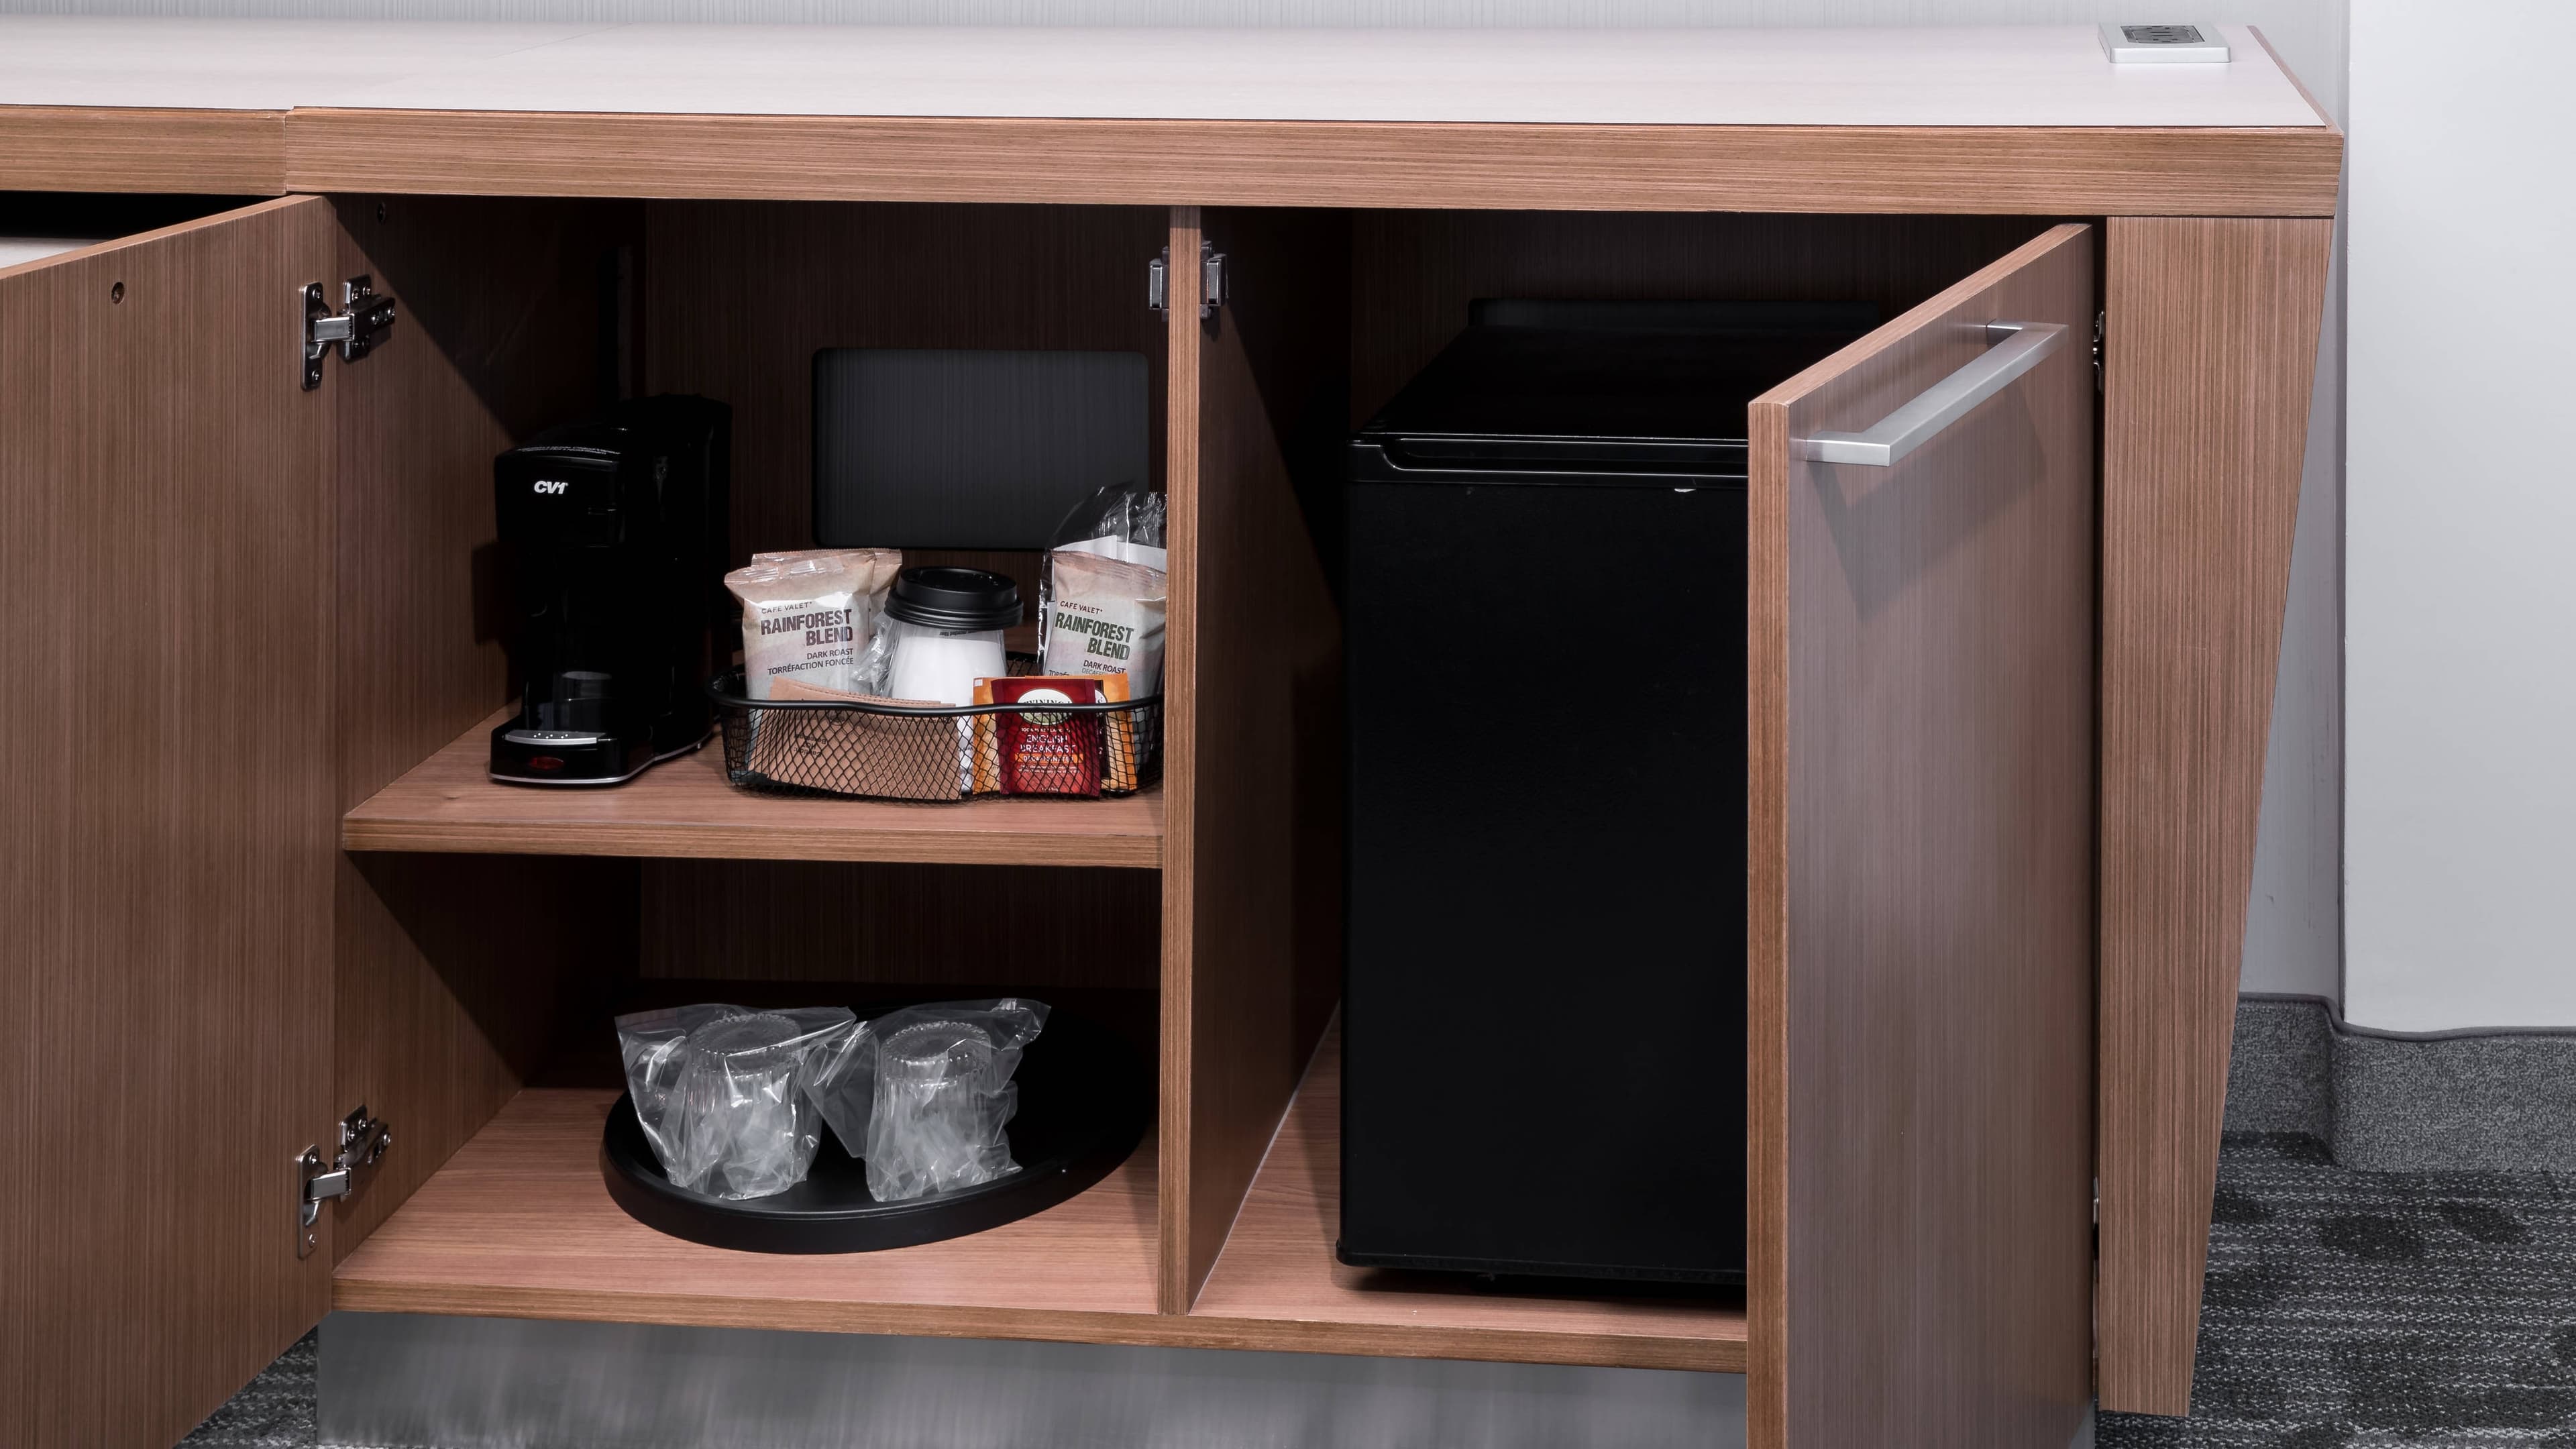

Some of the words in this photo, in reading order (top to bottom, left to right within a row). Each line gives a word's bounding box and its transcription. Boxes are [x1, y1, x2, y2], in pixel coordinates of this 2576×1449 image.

[761, 608, 853, 635] RAINFOREST
[1055, 612, 1134, 643] RAINFOREST
[806, 626, 853, 646] BLEND
[807, 651, 828, 660] DARK
[829, 648, 854, 657] ROAST
[1087, 637, 1130, 661] BLEND
[767, 661, 824, 676] TORRÉFACTION
[824, 657, 854, 667] FONCÉE
[1083, 659, 1103, 669] DARK
[1102, 663, 1126, 674] ROAST
[1020, 744, 1077, 753] BREAKFAST
[1026, 735, 1068, 743] ENGLISH
